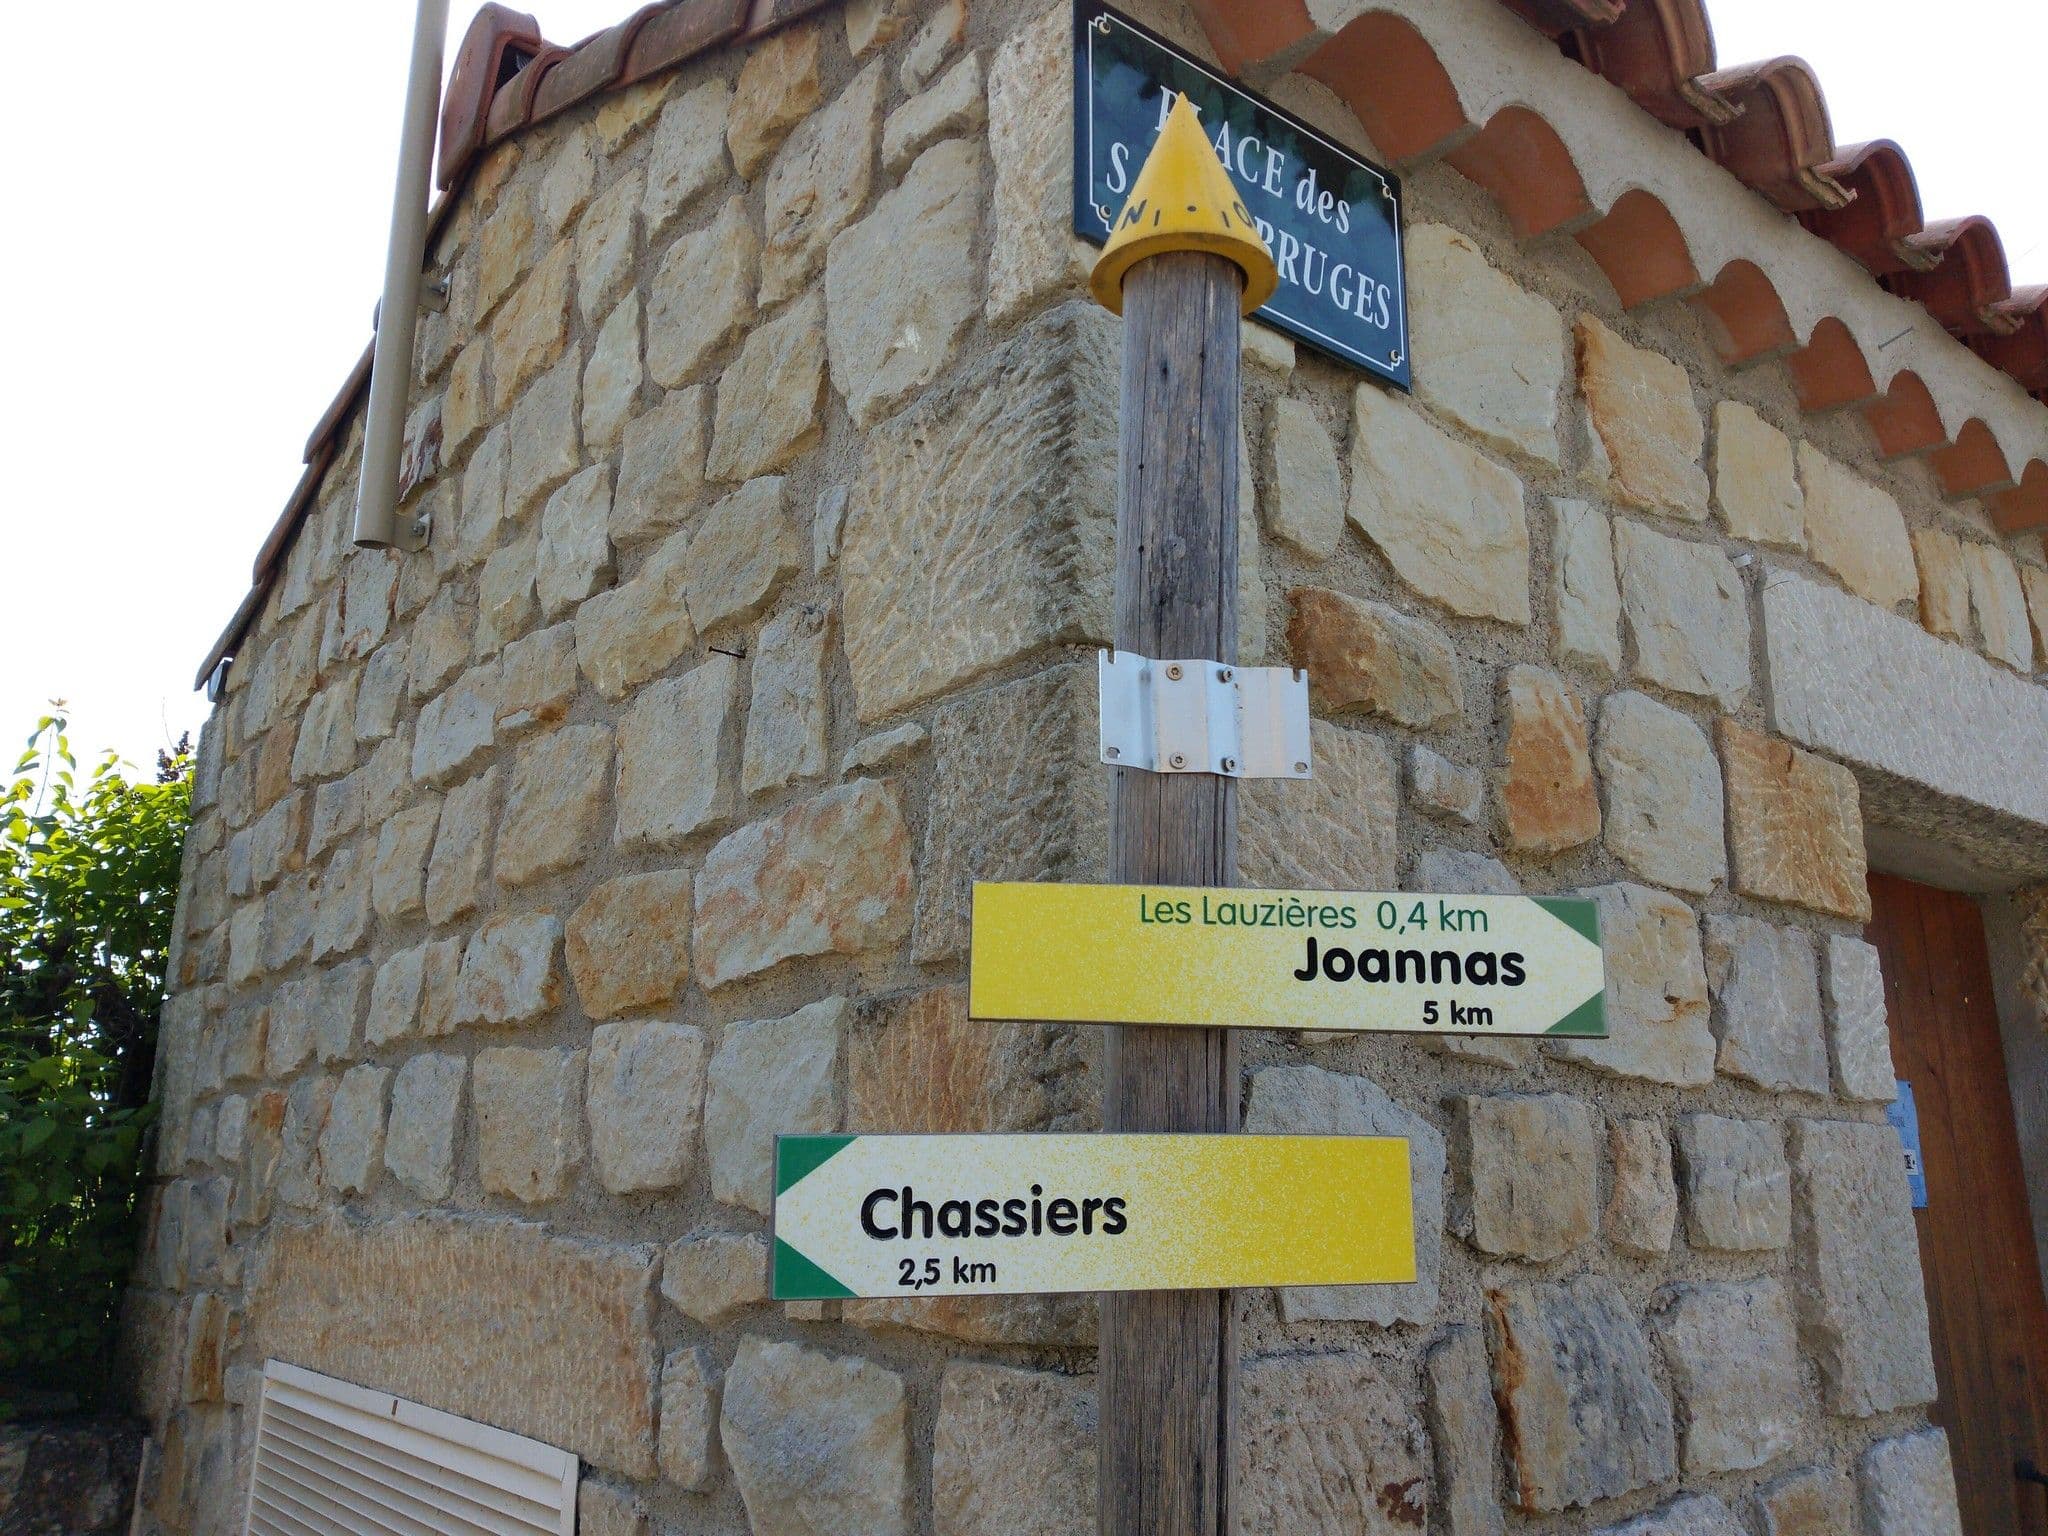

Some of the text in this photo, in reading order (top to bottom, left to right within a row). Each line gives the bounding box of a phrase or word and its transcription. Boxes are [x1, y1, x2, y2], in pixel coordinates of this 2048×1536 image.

[1154, 85, 1285, 199] PACE
[1296, 168, 1350, 234] des
[1140, 893, 1489, 936] Les Lauzières 0,4 km
[1294, 937, 1527, 987] Joannas
[1422, 1000, 1494, 1026] 5 km
[860, 1183, 1128, 1242] Chassiers
[898, 1255, 998, 1291] 2,5 km
